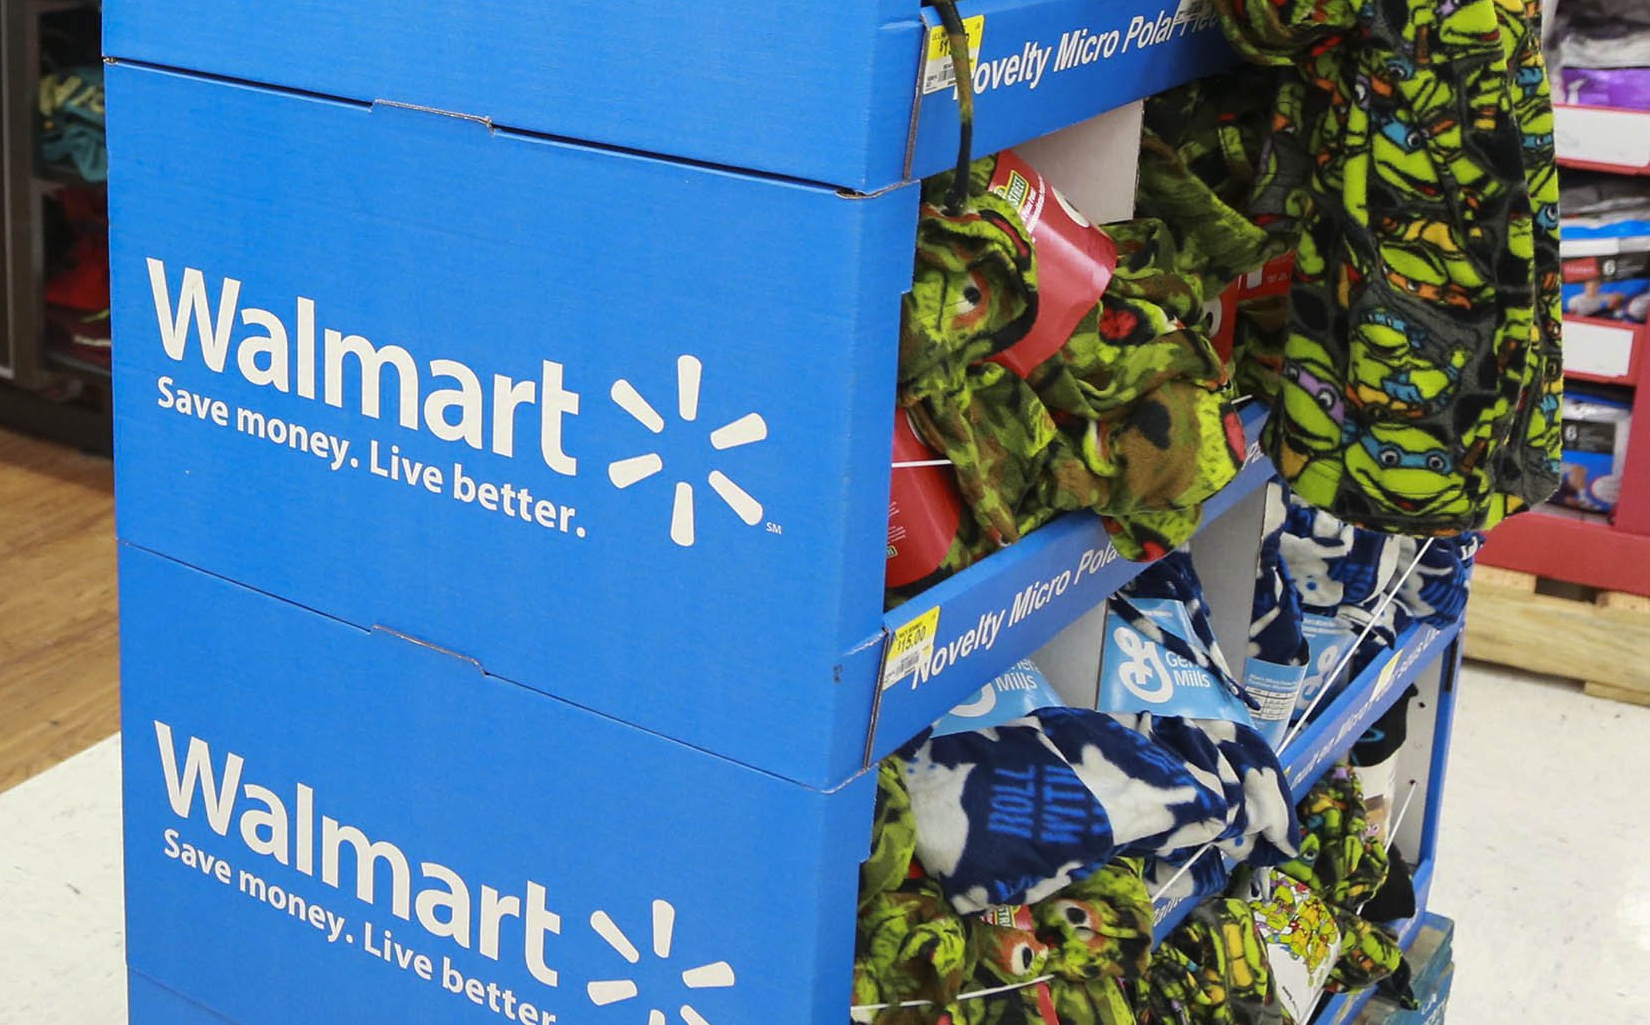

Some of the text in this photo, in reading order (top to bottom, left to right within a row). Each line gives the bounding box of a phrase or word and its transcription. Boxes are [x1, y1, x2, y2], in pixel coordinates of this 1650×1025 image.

[1053, 28, 1120, 72] Micro
[1121, 9, 1179, 54] Polar
[146, 256, 580, 476] Walmart
[157, 375, 587, 539] Save money. Live better.
[911, 540, 1120, 690] Novelty Micro Pola
[995, 671, 1038, 692] Mills
[1175, 670, 1211, 689] Mills
[153, 719, 561, 987] Walmart
[162, 827, 231, 885] Save
[238, 865, 354, 944] money.
[363, 921, 433, 981] Live
